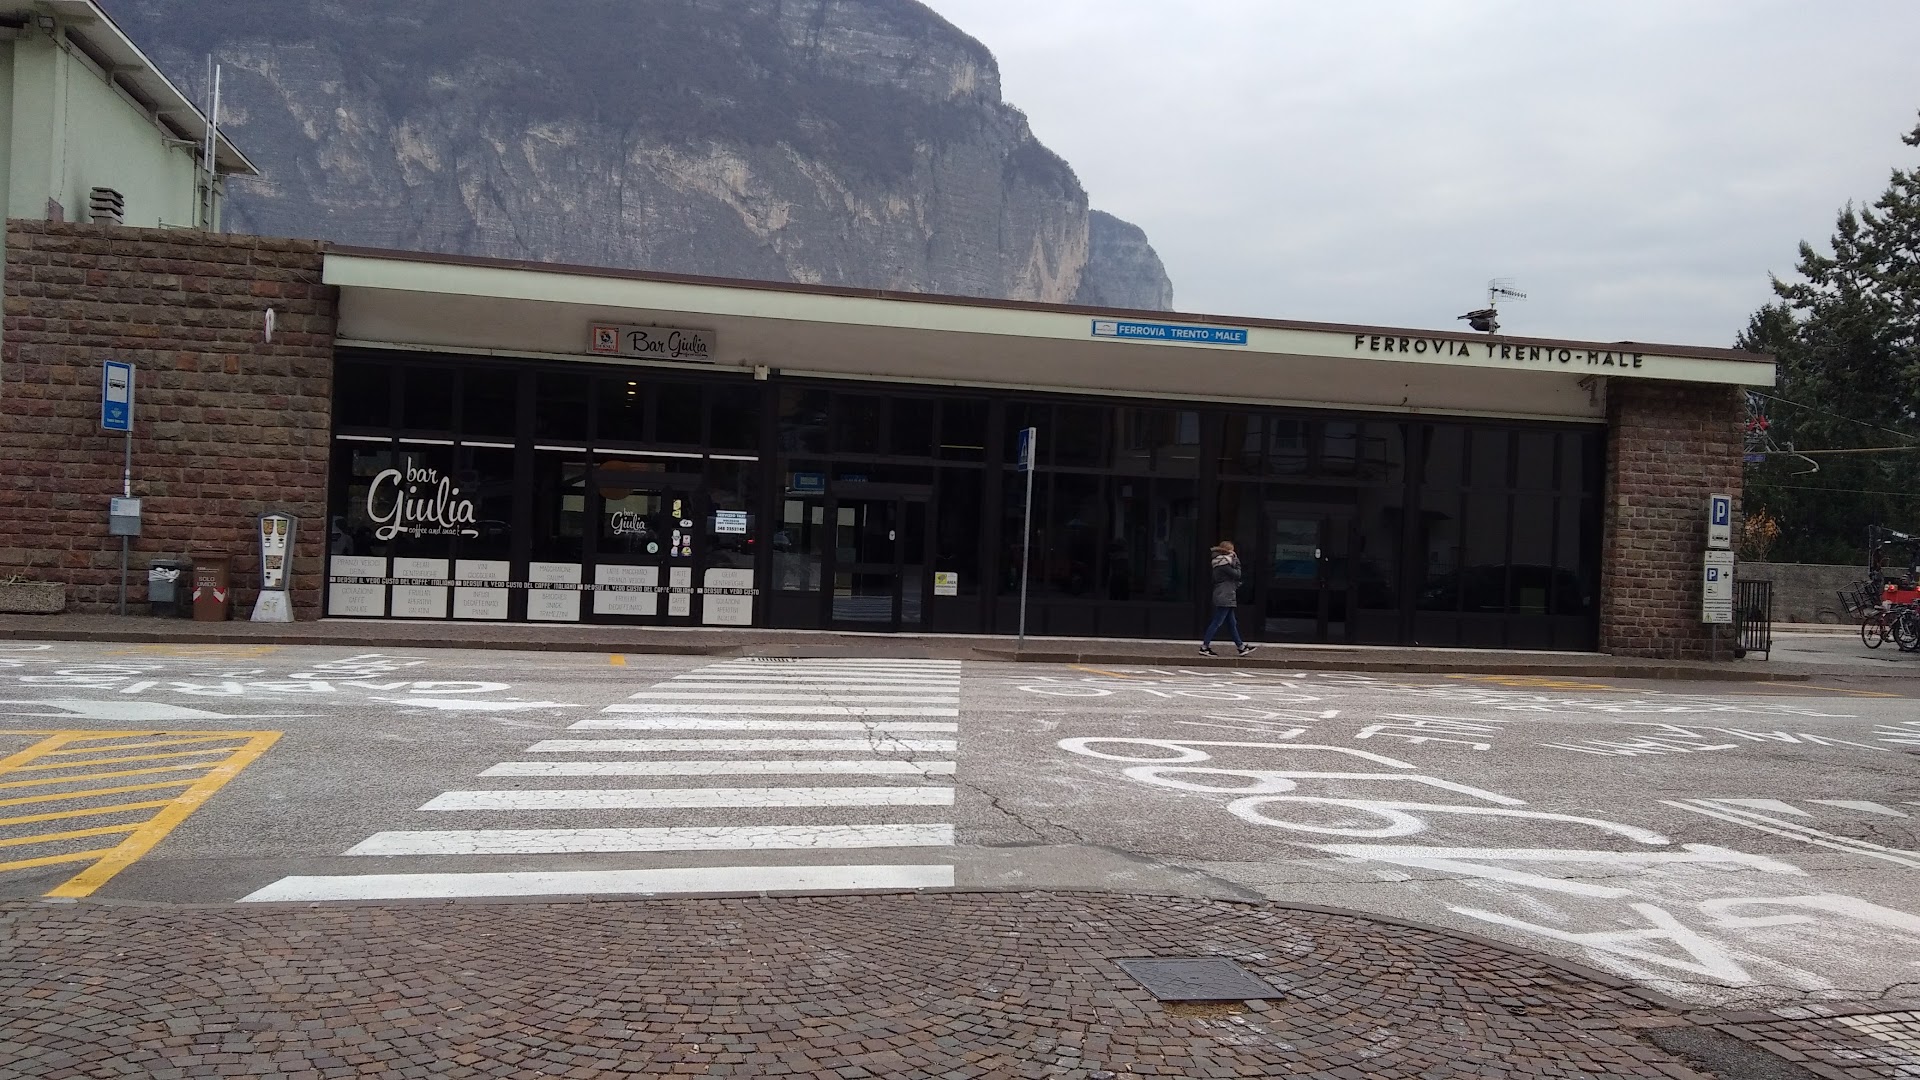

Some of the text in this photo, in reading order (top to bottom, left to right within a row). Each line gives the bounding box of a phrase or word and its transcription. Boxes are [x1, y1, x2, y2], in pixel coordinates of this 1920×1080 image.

[1119, 325, 1166, 336] FERROVIA
[1171, 329, 1209, 339] TRENTO
[626, 331, 707, 357] Bar Giulia
[1354, 335, 1471, 357] FERROVIA
[406, 456, 439, 484] bar
[367, 468, 476, 541] Giulia
[1716, 501, 1726, 523] P
[408, 523, 428, 538] coffee
[428, 525, 441, 535] and
[611, 511, 645, 535] Giulia
[1709, 569, 1716, 580] P
